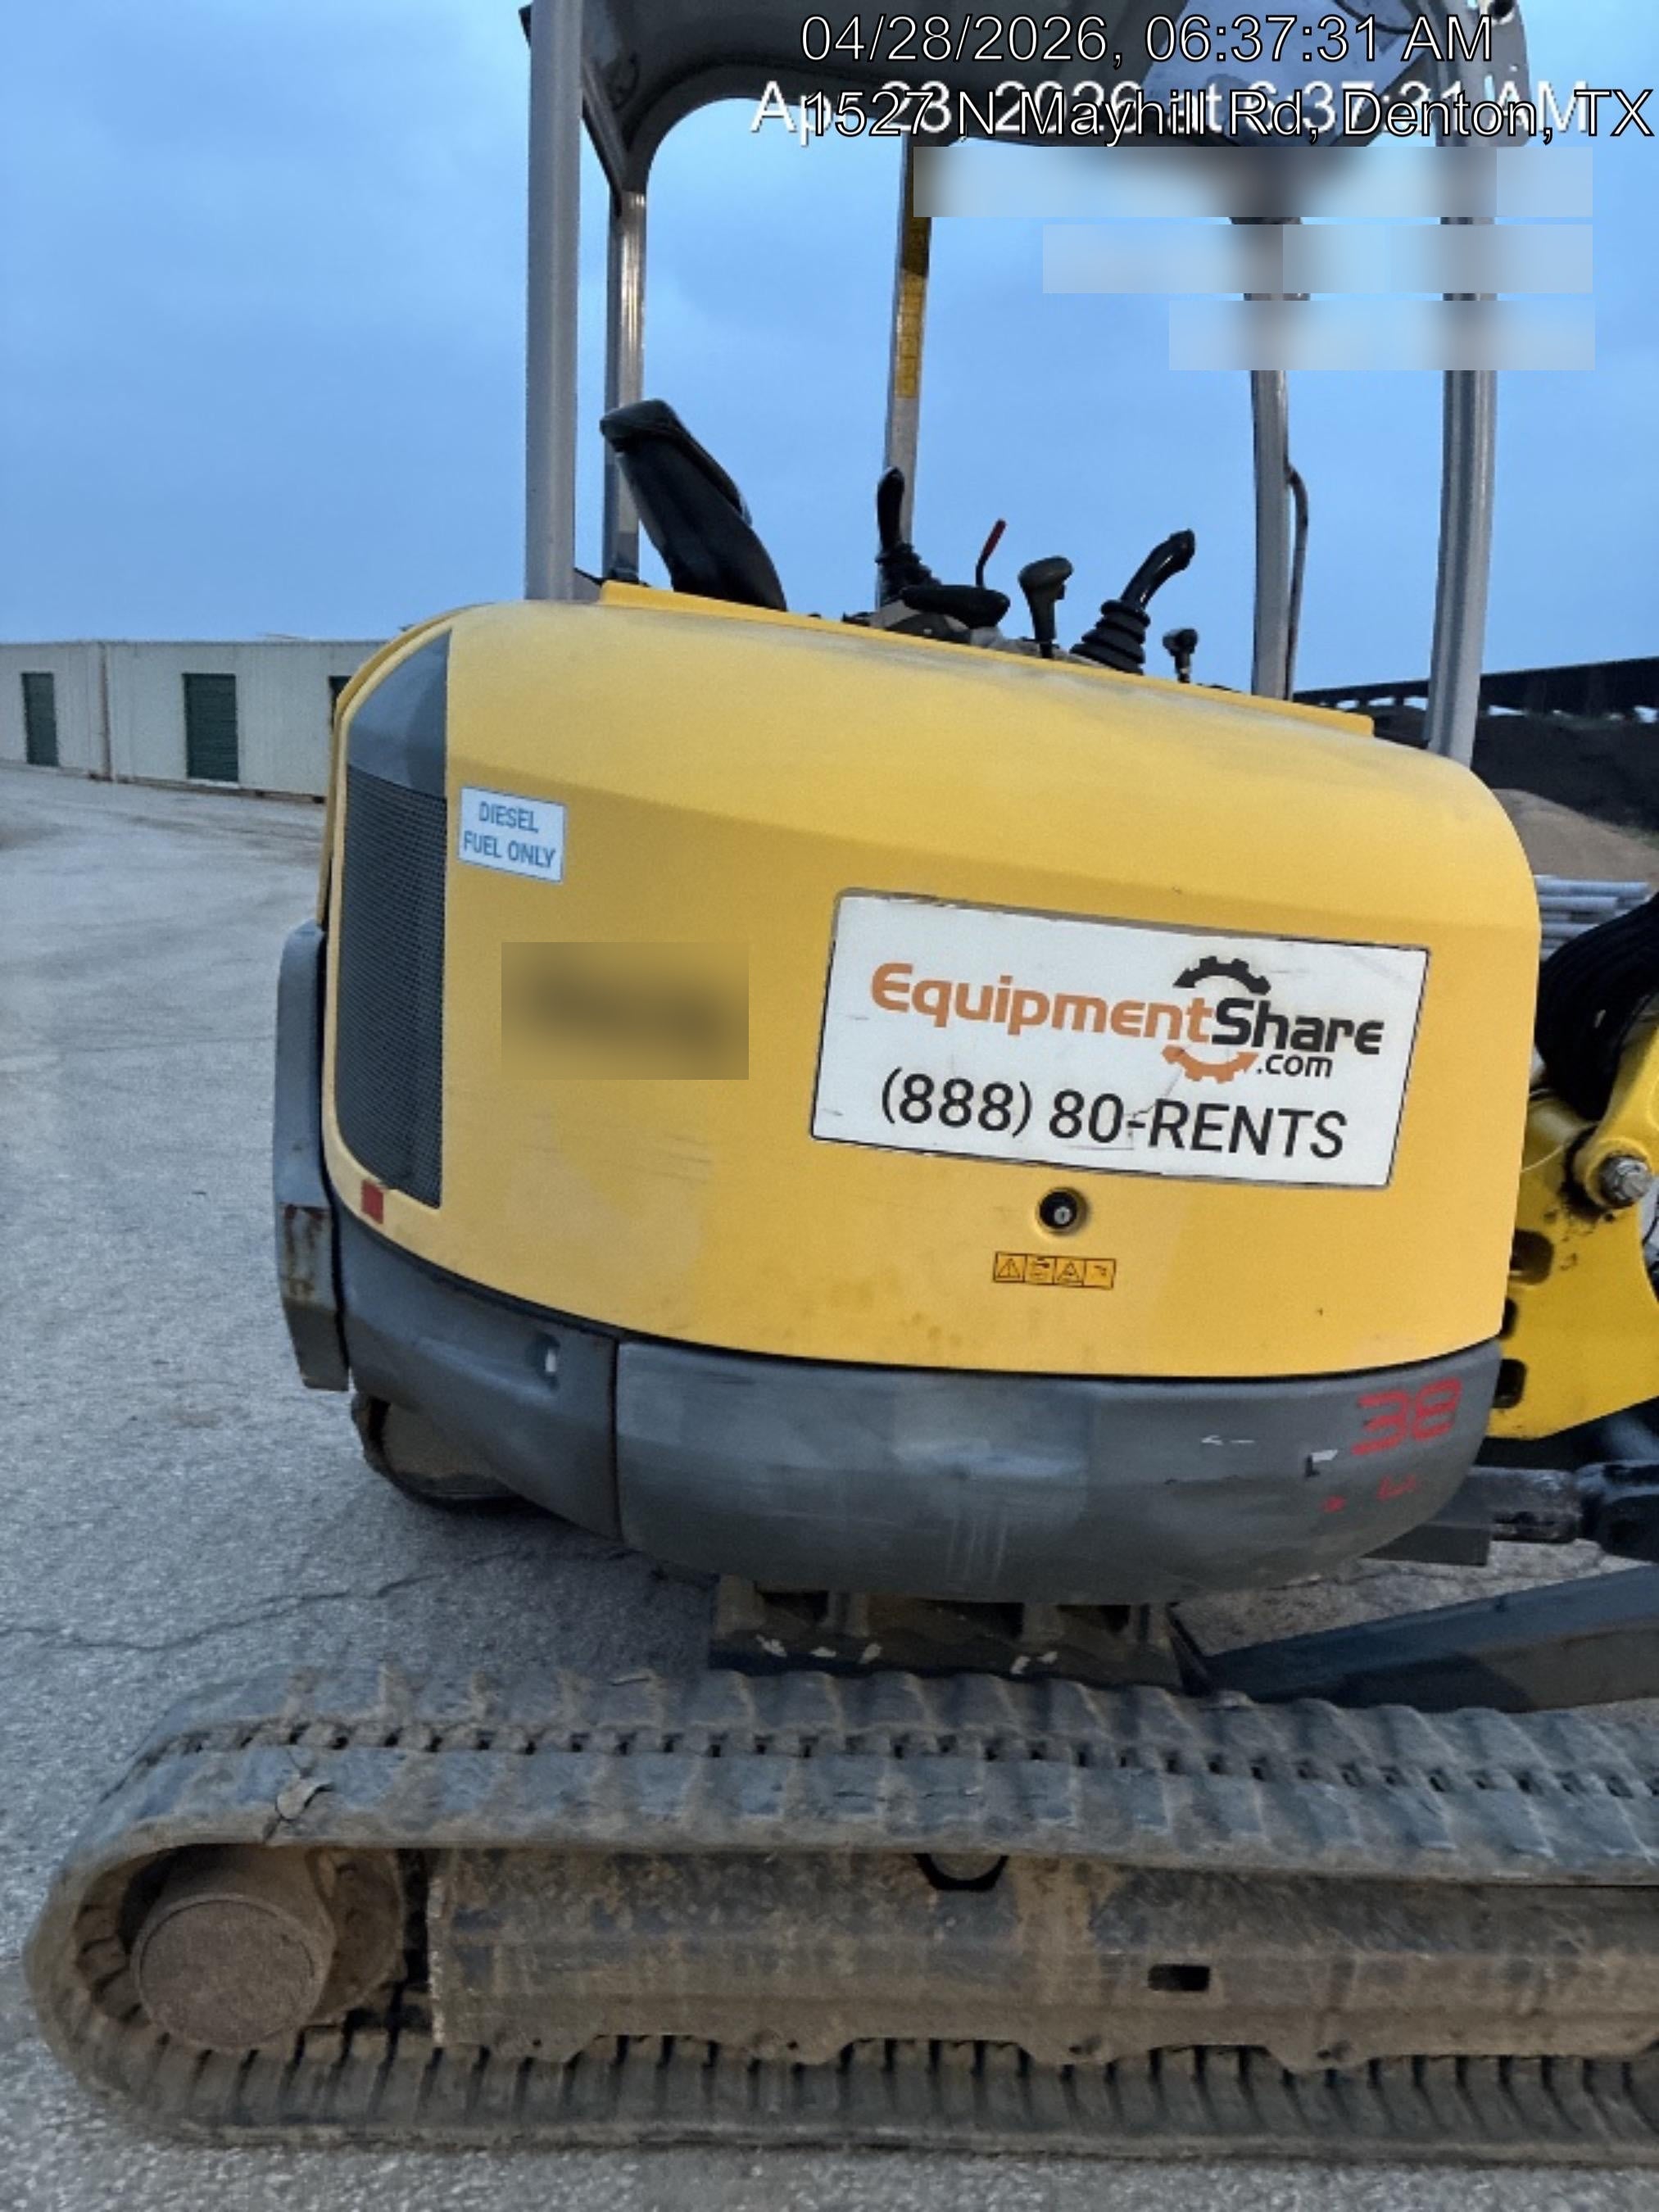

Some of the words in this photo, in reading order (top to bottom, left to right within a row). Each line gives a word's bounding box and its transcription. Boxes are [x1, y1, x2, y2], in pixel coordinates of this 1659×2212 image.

[478, 801, 538, 833] DIESEL
[464, 830, 502, 859] FUEL
[507, 840, 556, 868] ONLY
[870, 962, 1385, 1056] EquipmentShare
[1255, 1050, 1334, 1079] .com
[881, 1067, 1032, 1137] (888)
[1049, 1089, 1349, 1160] 80-RENTS
[1351, 1377, 1462, 1457] 38
